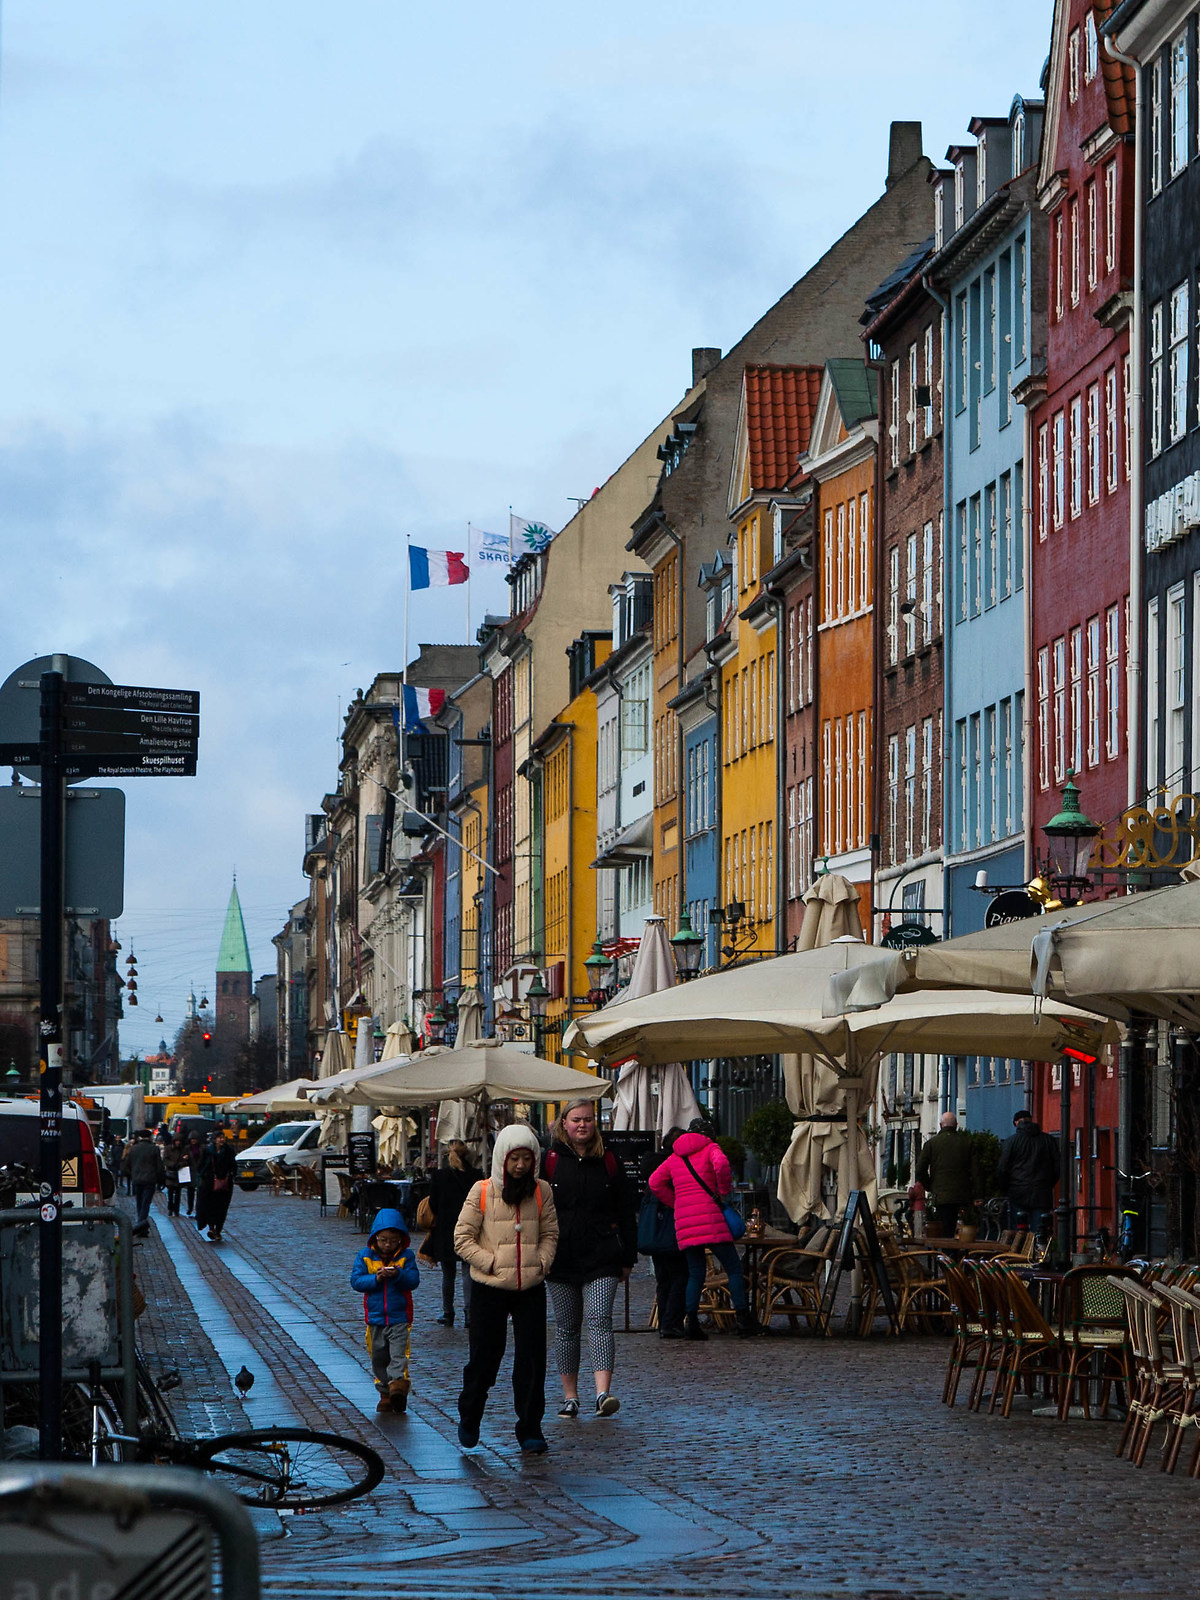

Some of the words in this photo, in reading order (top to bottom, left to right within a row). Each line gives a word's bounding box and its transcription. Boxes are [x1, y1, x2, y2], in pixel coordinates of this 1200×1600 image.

[88, 687, 101, 695] Den
[101, 688, 131, 698] Kongelige
[154, 716, 167, 724] Lille
[168, 717, 192, 726] Havfrue
[139, 738, 177, 748] Amalienborg
[178, 740, 191, 748] Slot
[142, 756, 185, 766] Skuespilhuset
